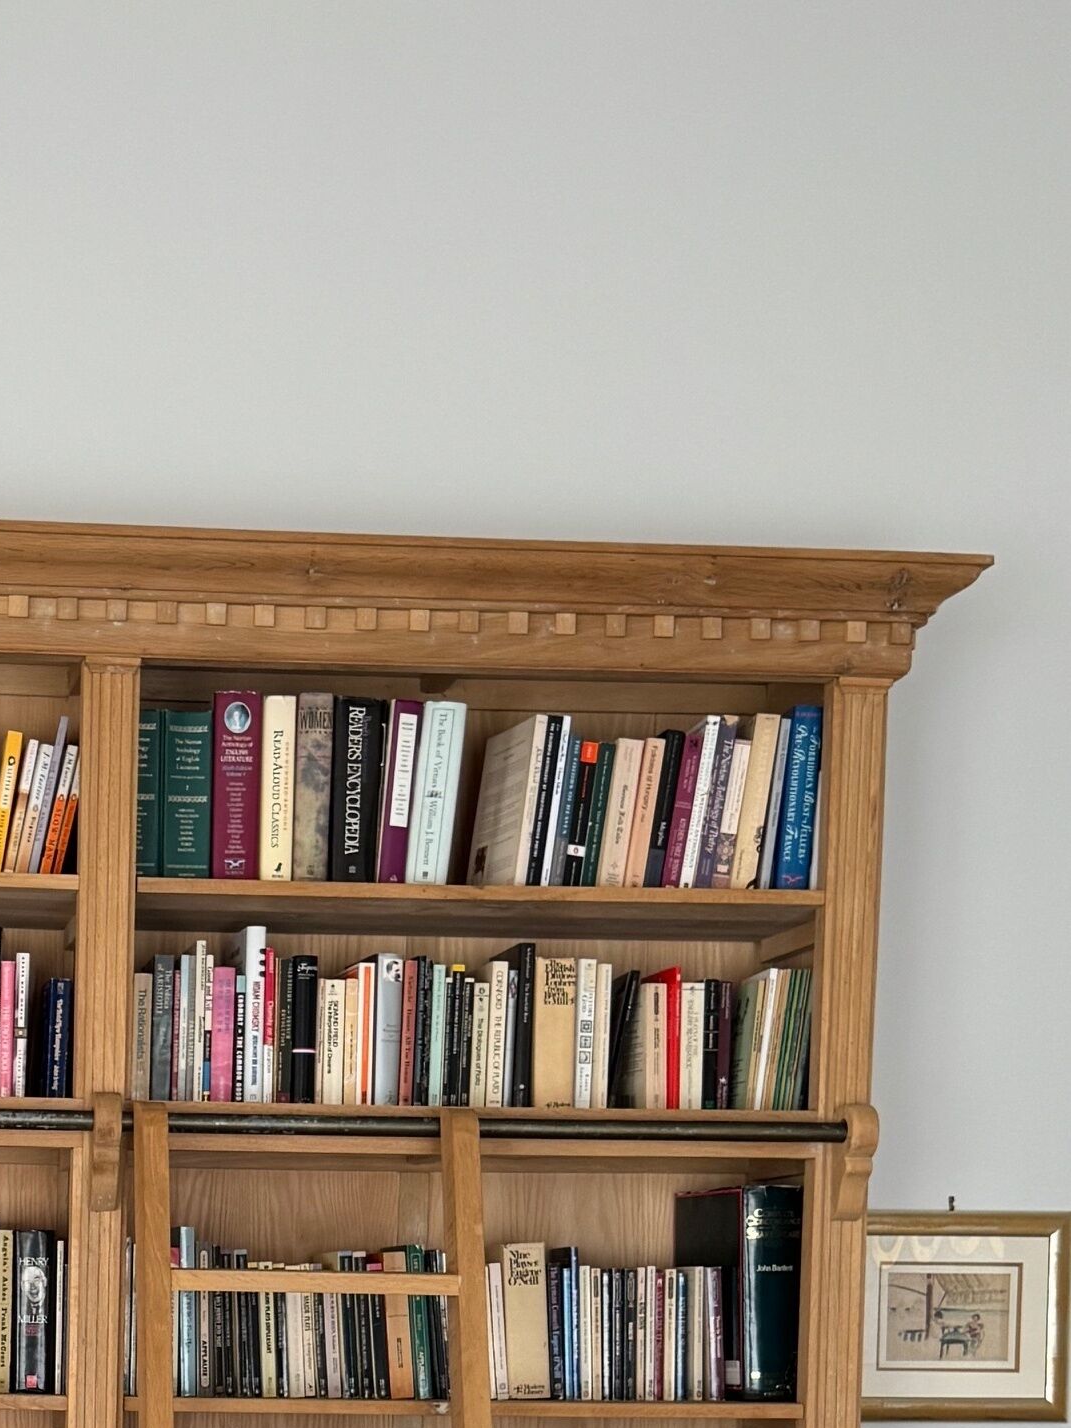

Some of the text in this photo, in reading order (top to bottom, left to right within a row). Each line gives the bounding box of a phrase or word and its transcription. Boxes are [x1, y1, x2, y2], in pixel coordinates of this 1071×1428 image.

[271, 730, 284, 848] READ-ALOUD CLASSICS
[344, 763, 361, 854] ENCYCLOPEDIA
[19, 1258, 48, 1266] HENRY
